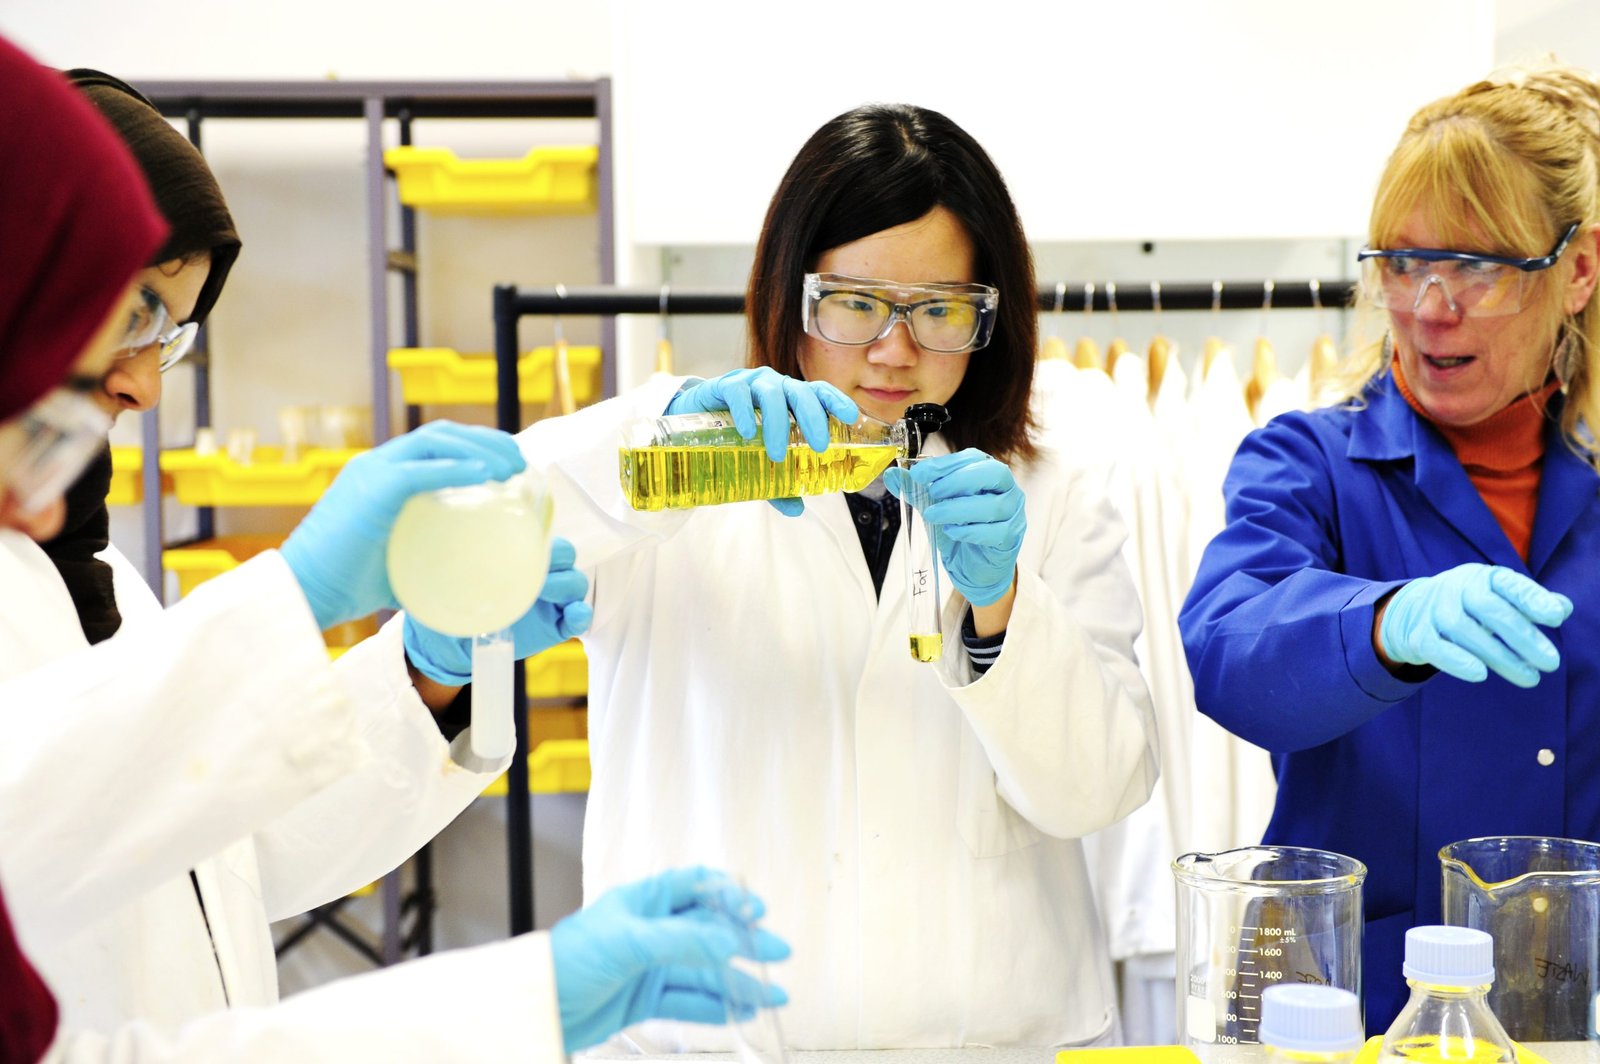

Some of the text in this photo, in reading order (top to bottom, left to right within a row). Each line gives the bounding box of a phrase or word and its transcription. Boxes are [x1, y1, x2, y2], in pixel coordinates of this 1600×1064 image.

[913, 569, 928, 597] Fat
[1259, 927, 1297, 937] 1800 mL
[1259, 948, 1283, 957] 1600
[1260, 970, 1283, 980] 1400
[1217, 1034, 1238, 1045] 1000
